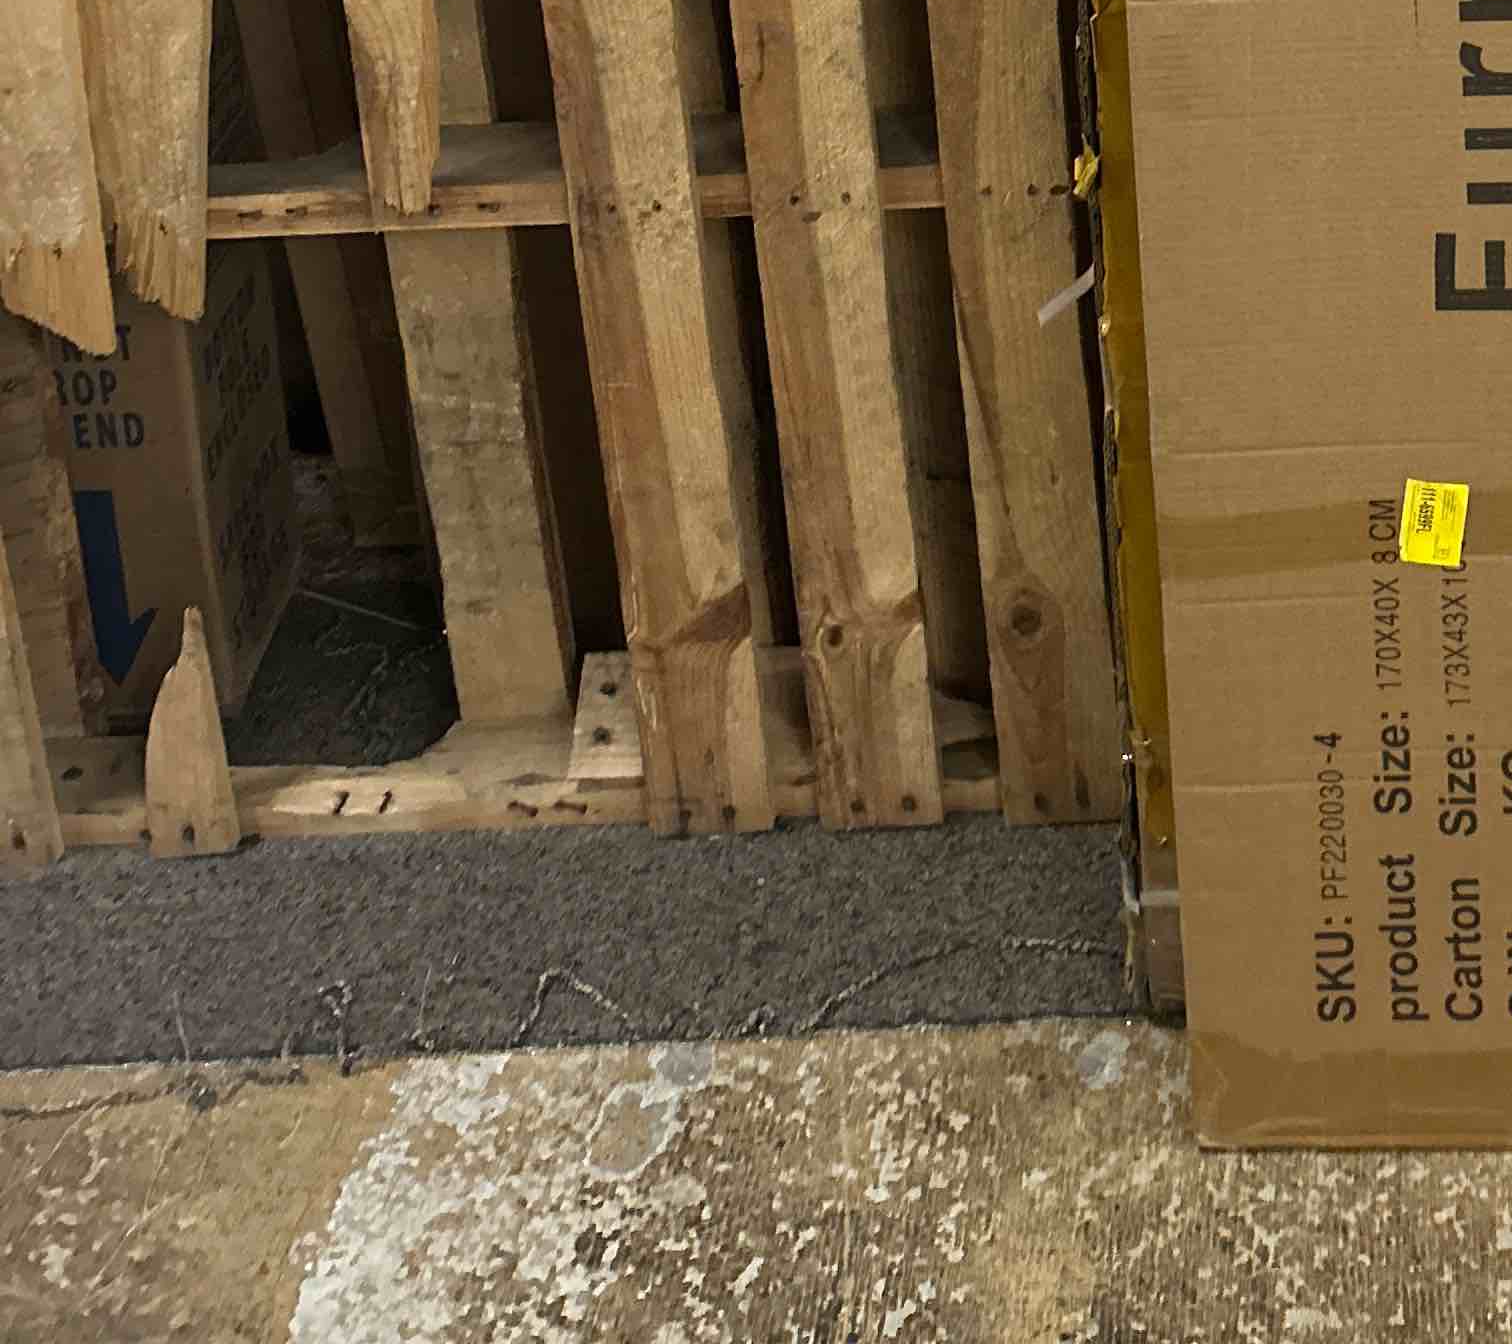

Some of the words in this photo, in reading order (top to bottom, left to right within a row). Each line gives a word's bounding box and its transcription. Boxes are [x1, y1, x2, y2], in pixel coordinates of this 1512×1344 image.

[73, 413, 144, 448] END
[1369, 498, 1396, 541] CM
[1313, 730, 1349, 901] PF220030-4
[1374, 712, 1412, 815] Size:
[1439, 732, 1478, 837] Size:
[1316, 915, 1355, 1023] SKU:
[1378, 854, 1429, 1023] product
[1444, 878, 1480, 1022] Carton
